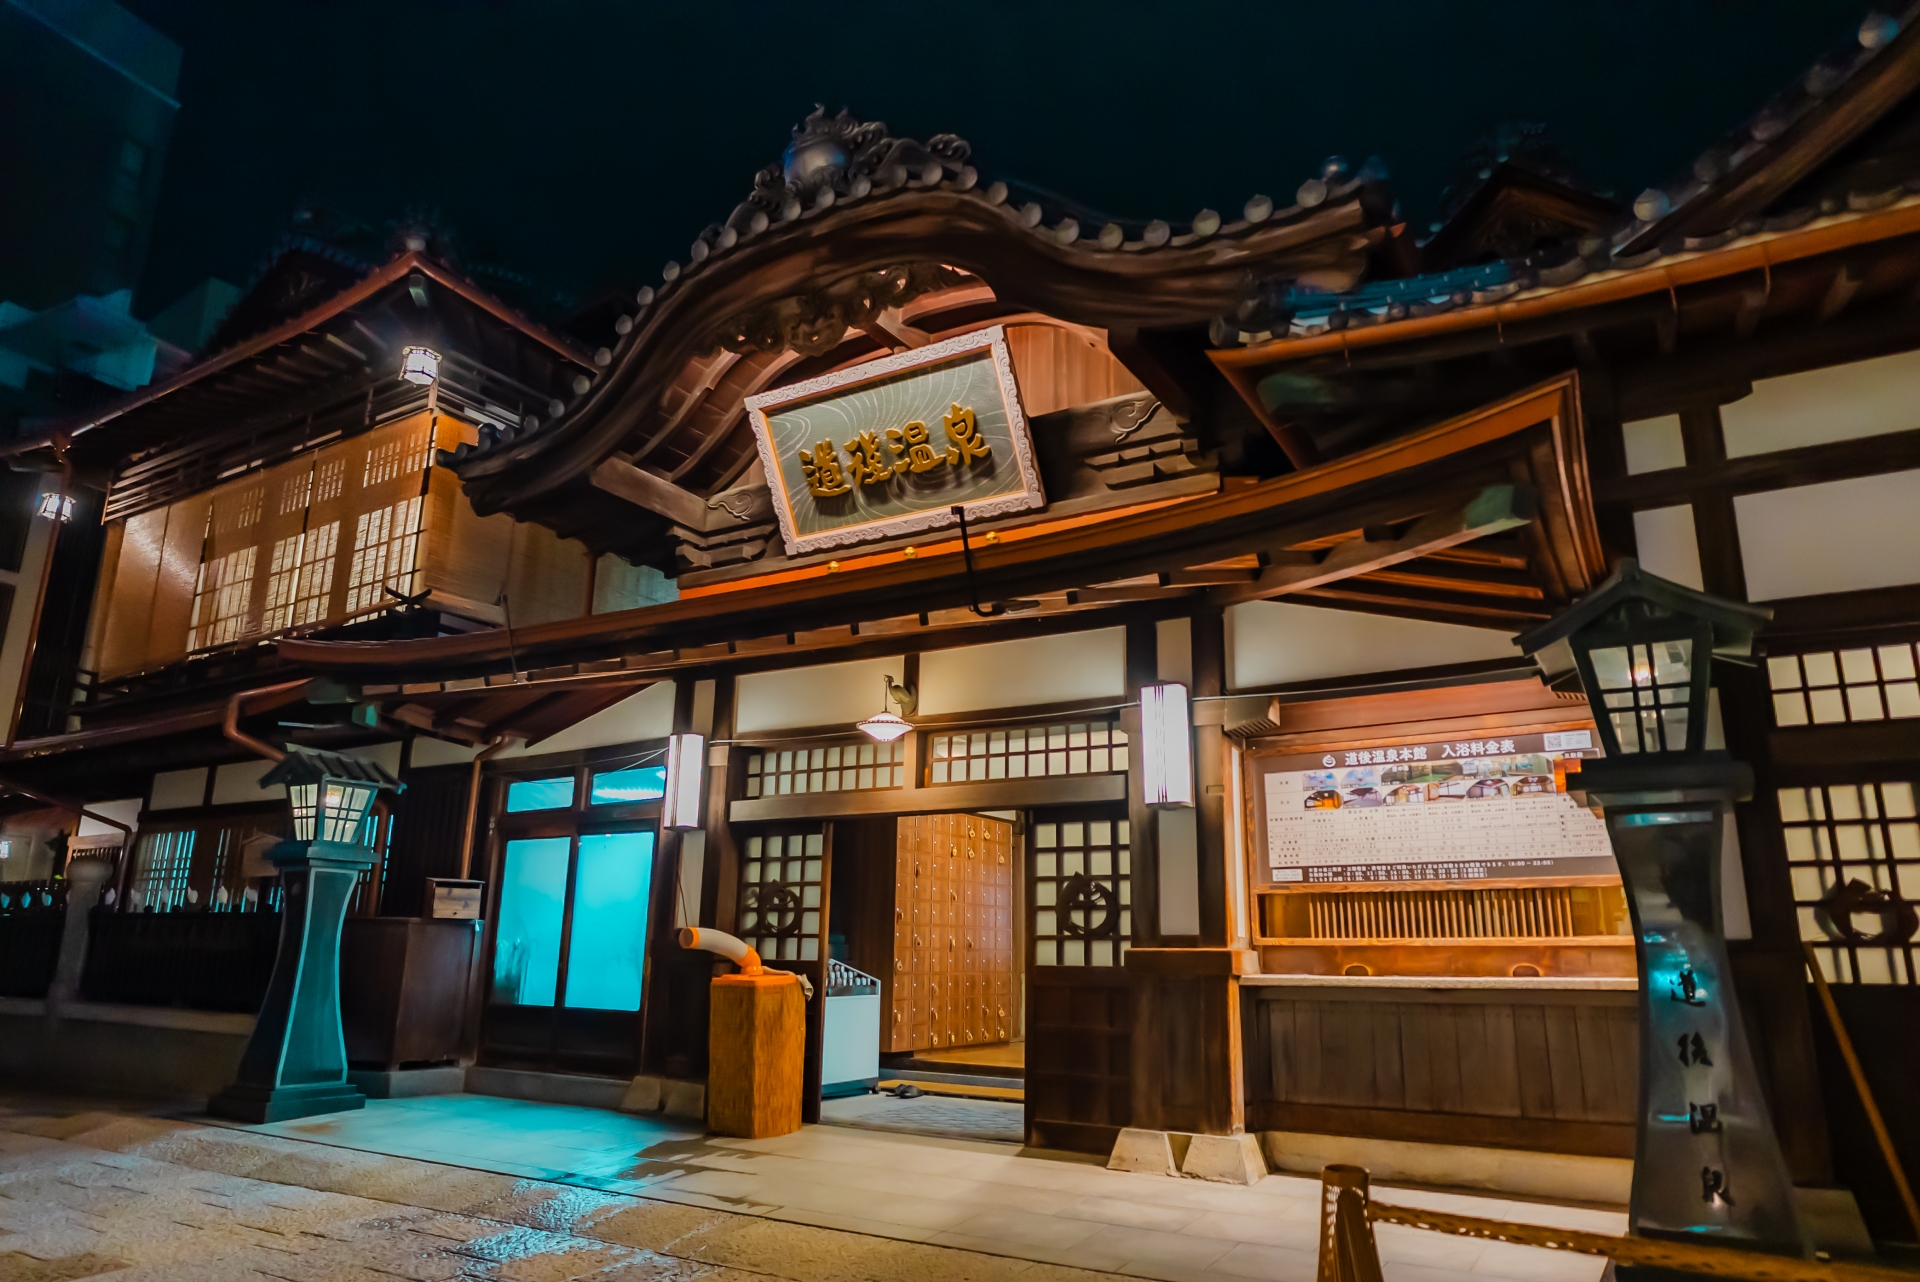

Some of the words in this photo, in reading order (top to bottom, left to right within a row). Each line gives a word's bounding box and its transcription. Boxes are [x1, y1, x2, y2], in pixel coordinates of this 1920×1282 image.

[798, 402, 991, 497] 道後温泉
[1344, 746, 1428, 766] 道後温泉本館
[1441, 739, 1516, 759] 入浴料金表
